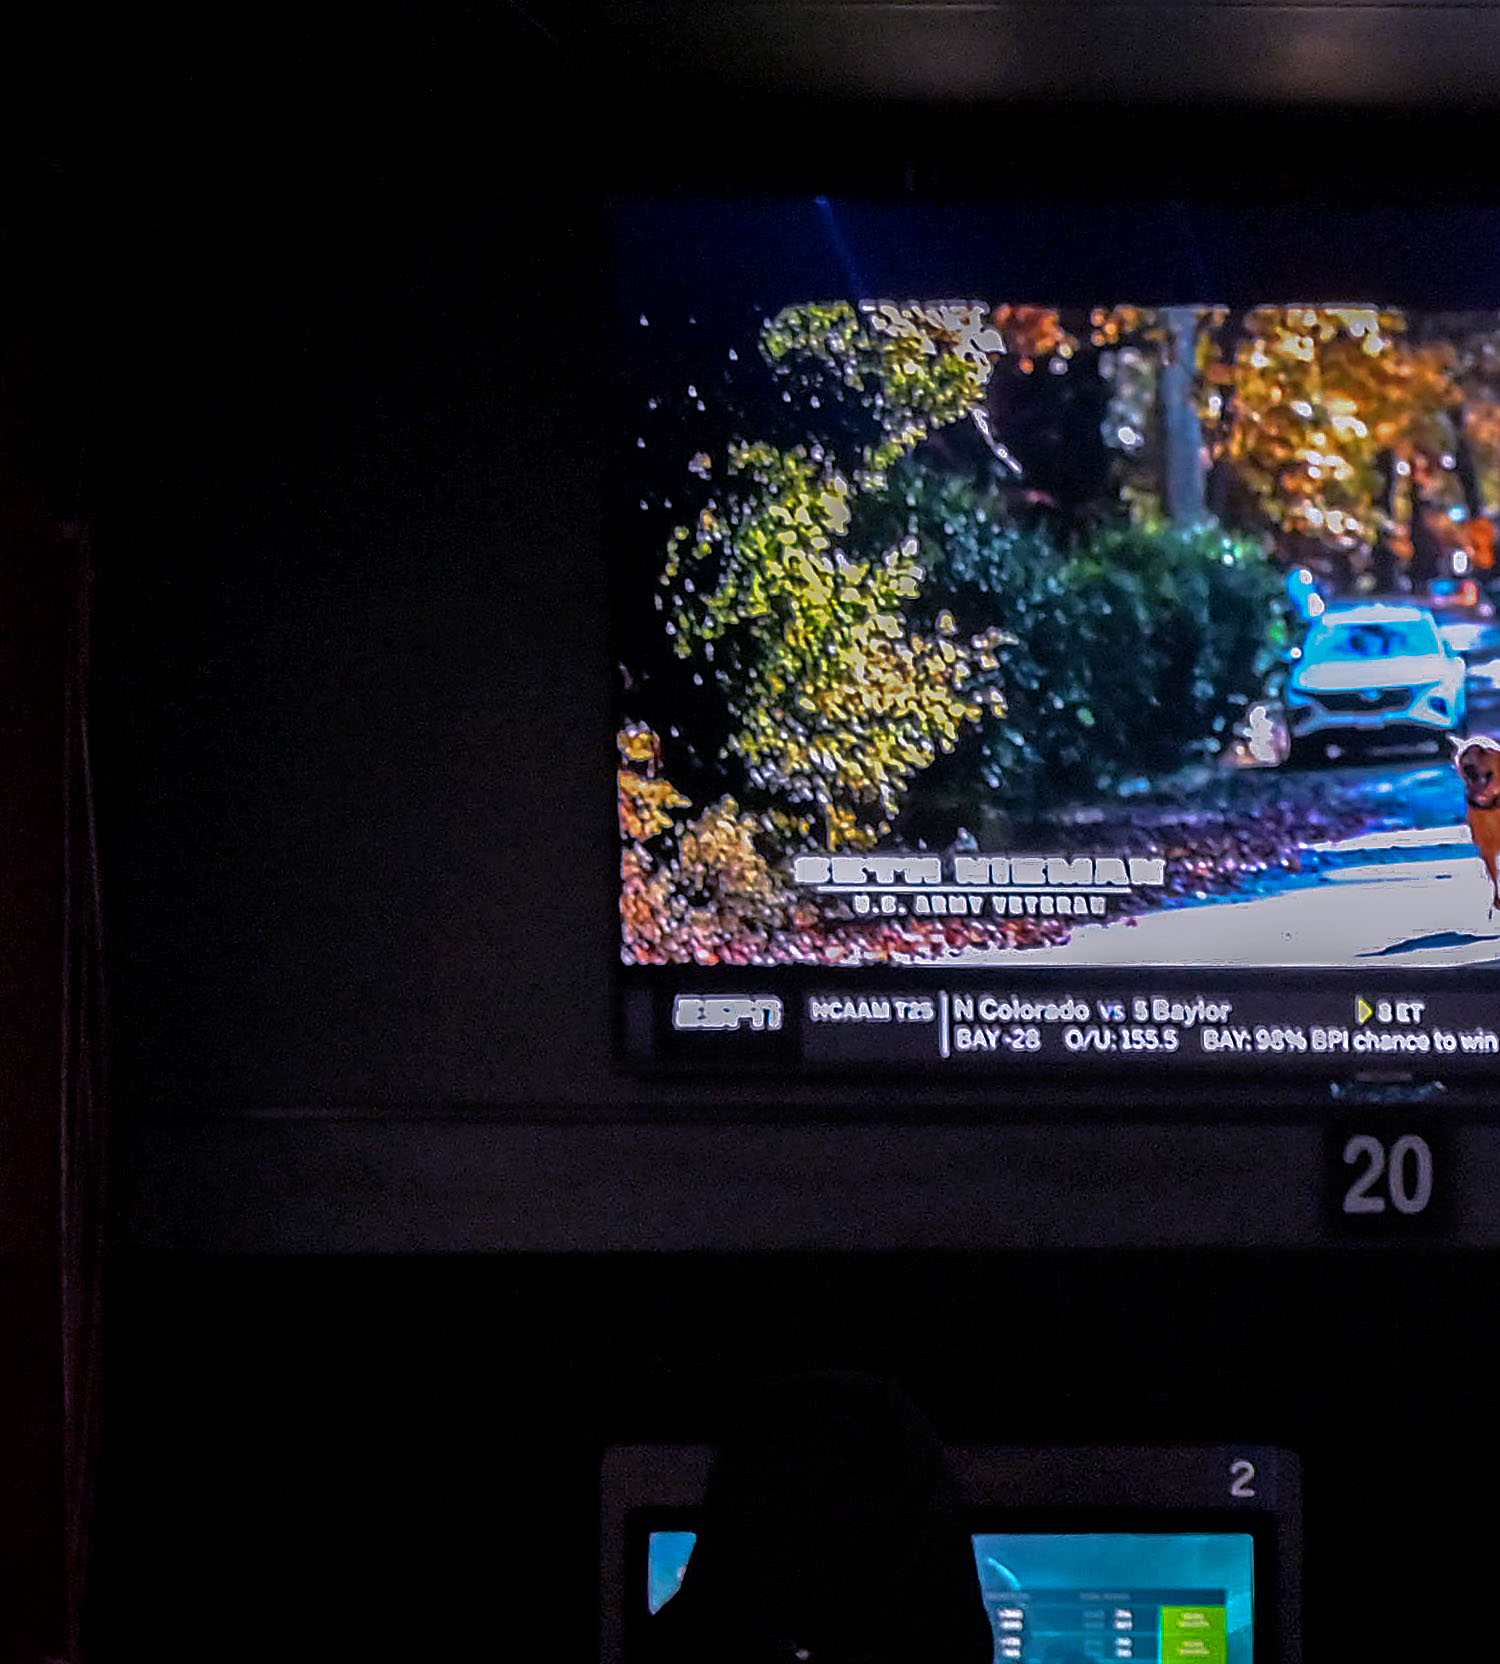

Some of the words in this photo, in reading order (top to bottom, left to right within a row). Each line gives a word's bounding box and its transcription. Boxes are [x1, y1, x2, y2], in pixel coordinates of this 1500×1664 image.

[954, 1000, 977, 1022] N
[979, 1000, 1090, 1022] Colorado
[1101, 1005, 1124, 1022] vs
[1153, 1000, 1232, 1026] Baylor
[1343, 1134, 1432, 1214] 20
[1230, 1461, 1256, 1498] 2
